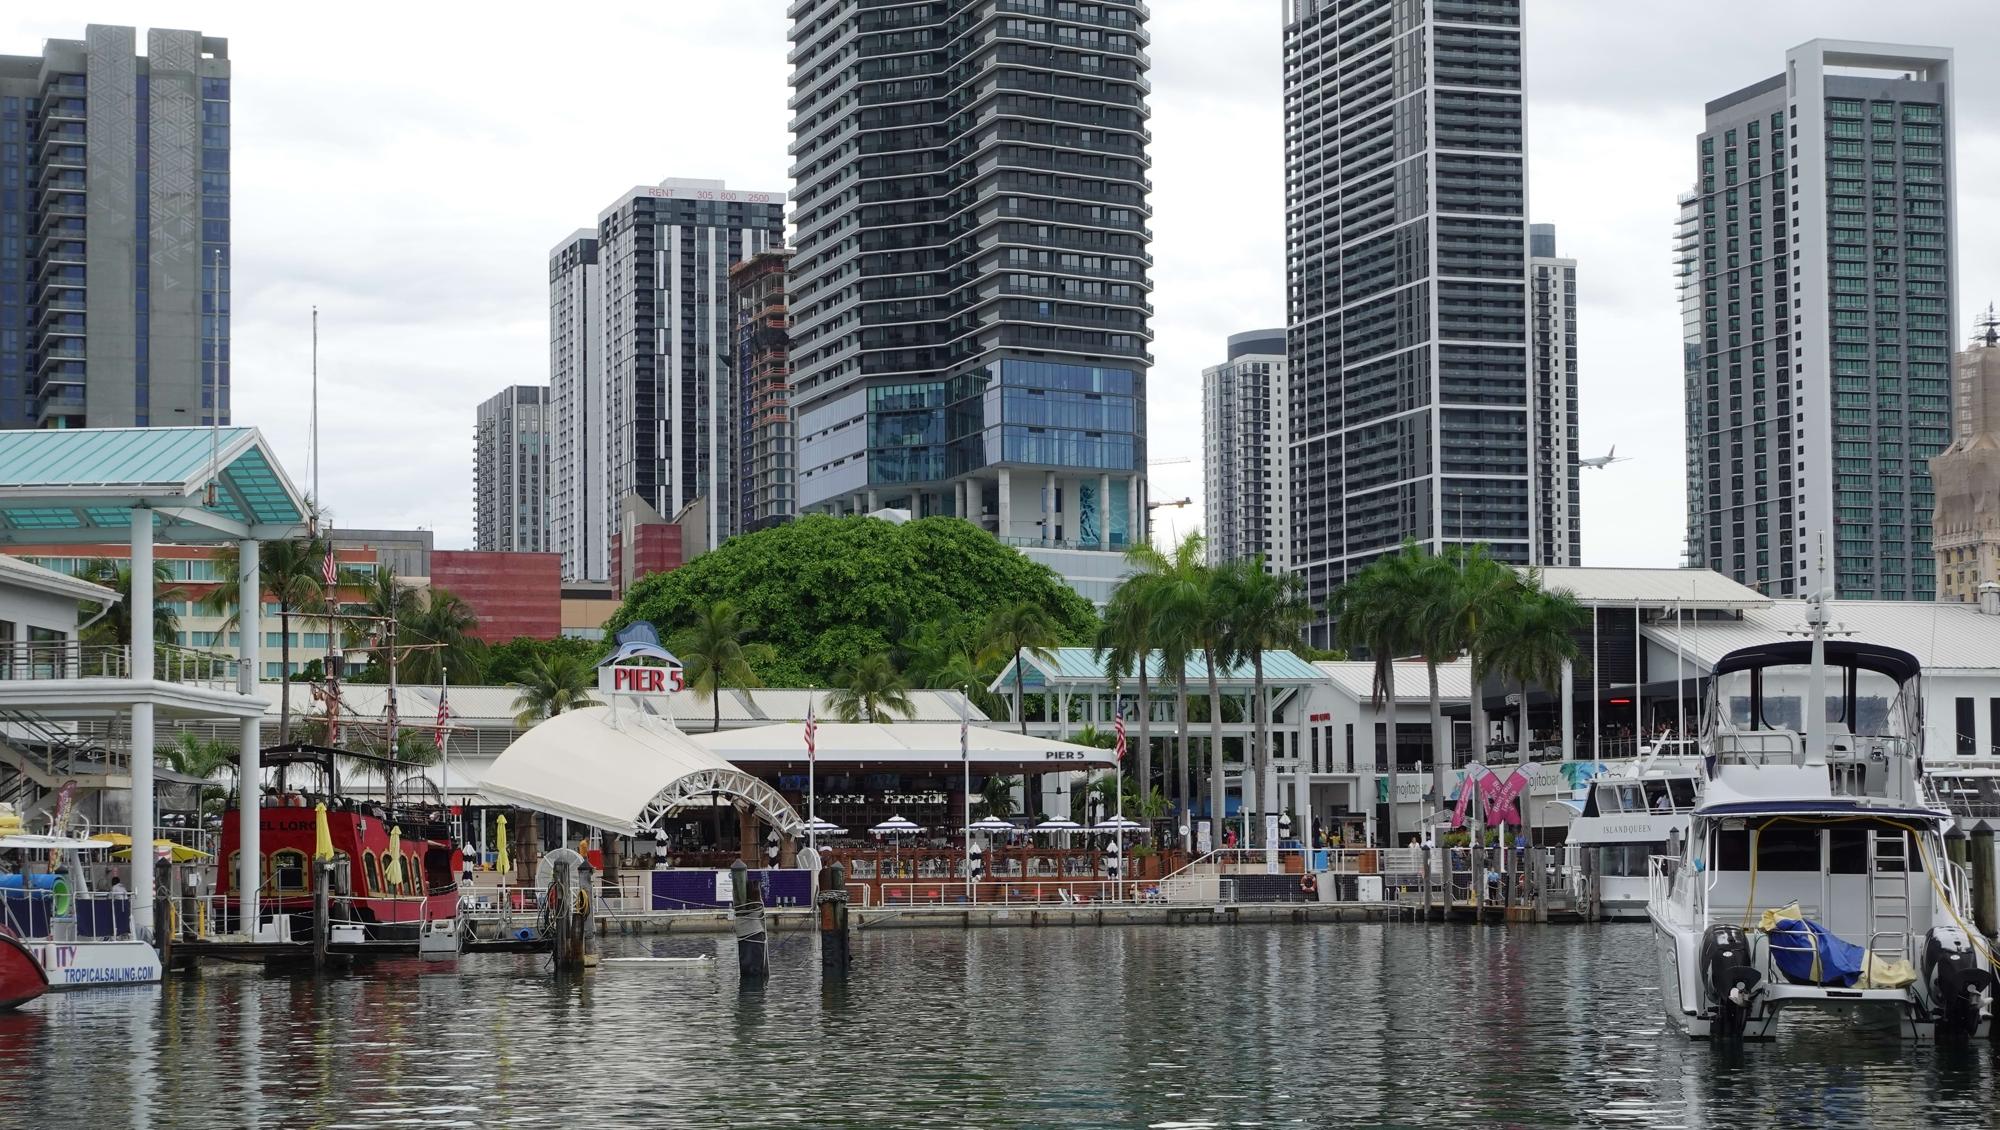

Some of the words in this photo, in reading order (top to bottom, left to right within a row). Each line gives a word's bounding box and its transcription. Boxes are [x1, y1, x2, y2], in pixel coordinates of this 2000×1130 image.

[648, 188, 674, 197] RENT
[697, 190, 713, 200] 305
[720, 192, 737, 201] 800
[748, 193, 770, 203] 2500
[615, 668, 665, 692] PIER
[669, 670, 685, 693] 5
[1046, 751, 1074, 760] PIER
[1077, 751, 1085, 760] 5
[260, 821, 275, 831] EL
[64, 966, 154, 983] TROPICALSAILING.COM
